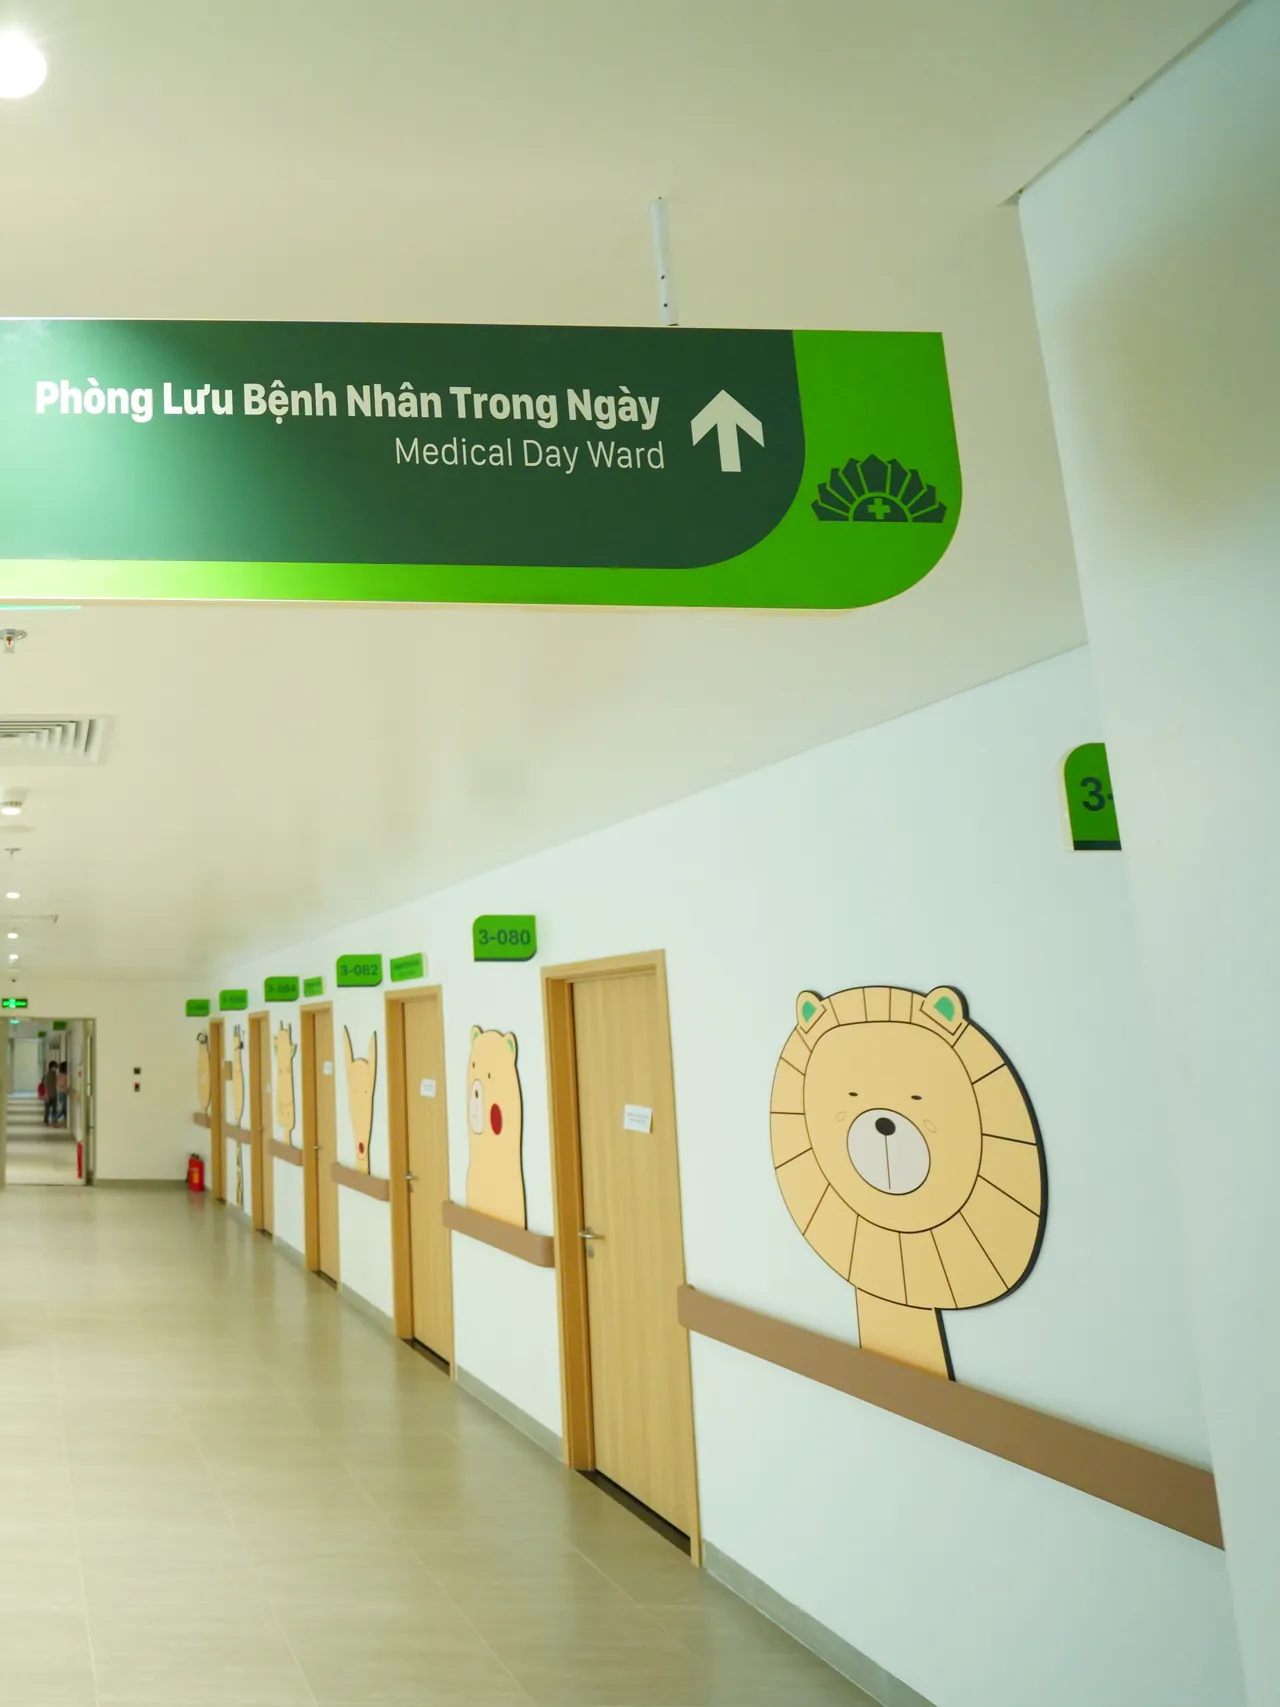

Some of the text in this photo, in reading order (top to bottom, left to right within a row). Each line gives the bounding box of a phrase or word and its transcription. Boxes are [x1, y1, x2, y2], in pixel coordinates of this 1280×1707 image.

[35, 377, 661, 431] Phòng Lưu Bệnh Nhân Trong Ngày
[395, 437, 666, 475] Medical Day Ward
[478, 929, 532, 946] 3-080
[340, 964, 379, 976] 3-082
